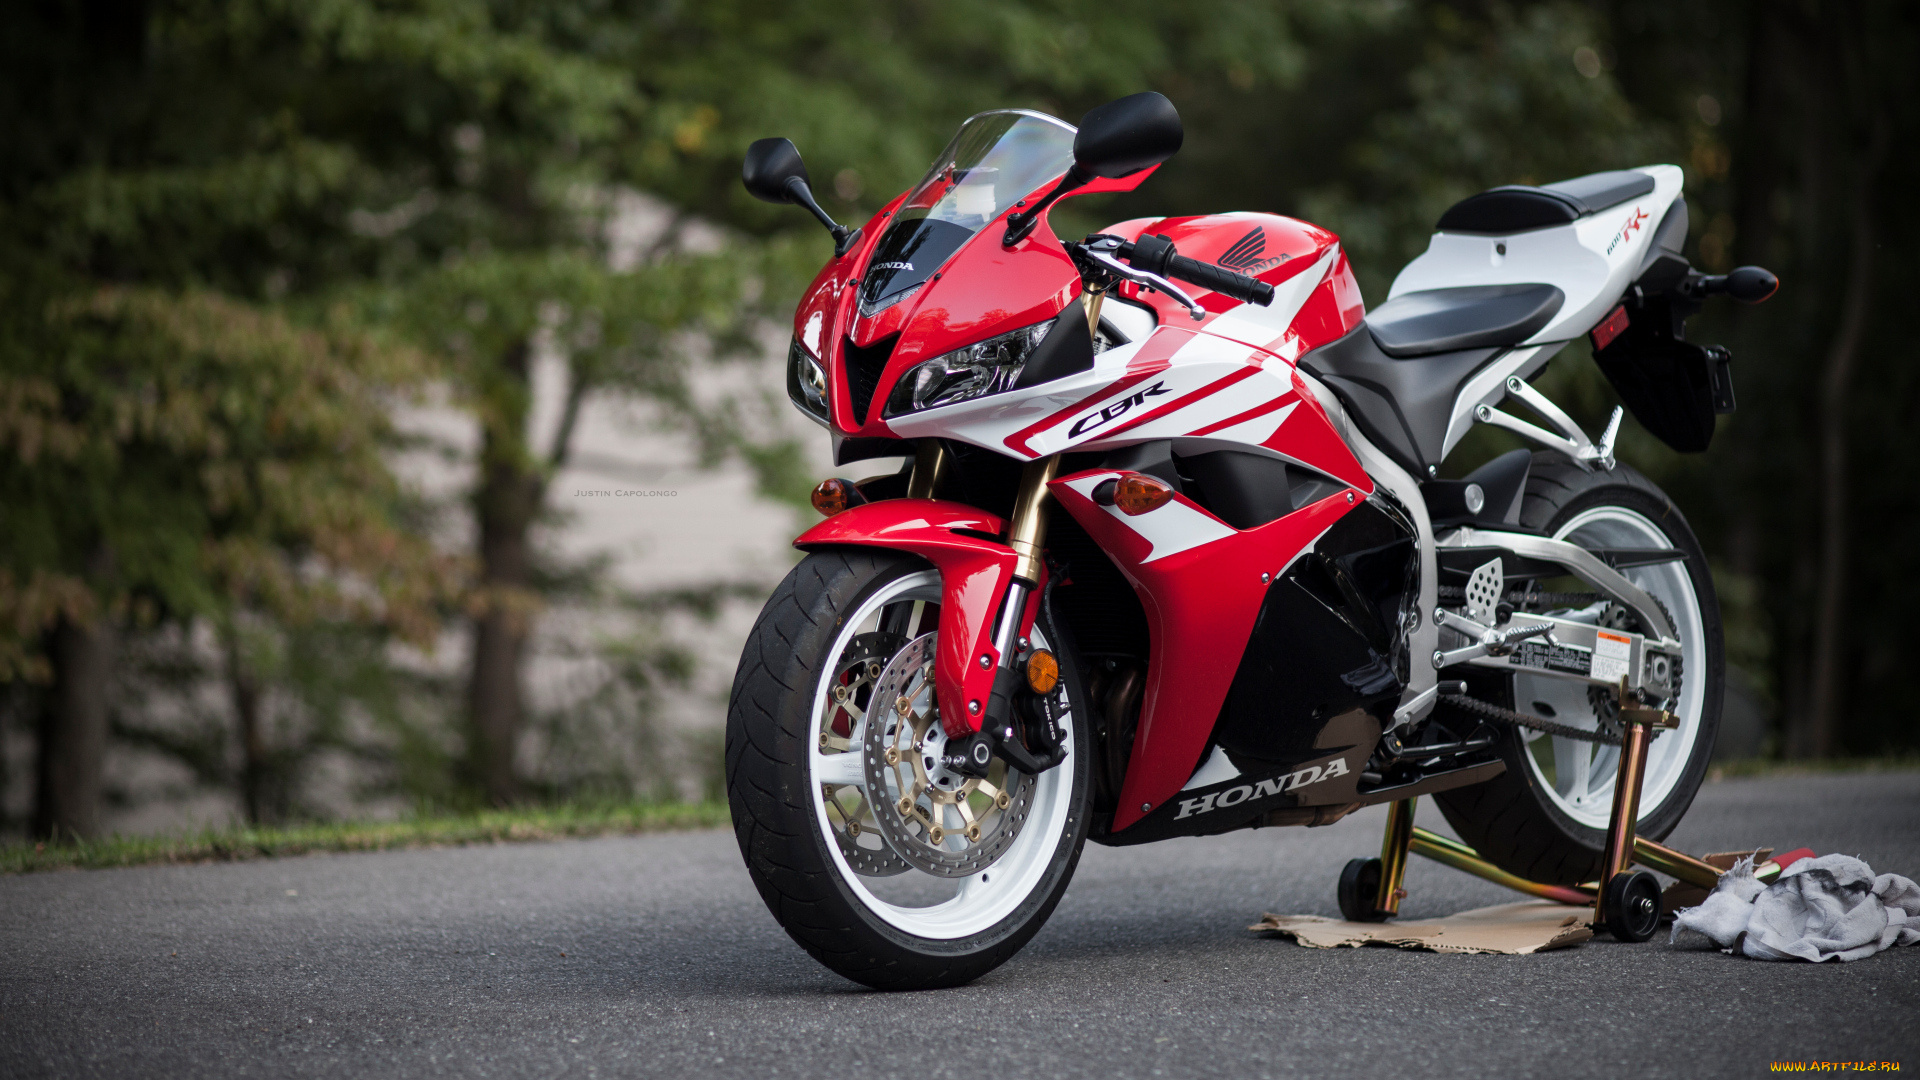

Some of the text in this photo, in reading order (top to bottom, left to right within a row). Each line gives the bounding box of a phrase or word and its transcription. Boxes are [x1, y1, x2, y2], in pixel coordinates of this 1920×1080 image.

[1238, 252, 1294, 276] ONDA
[1068, 380, 1174, 439] CBR
[1043, 697, 1056, 740] TOKICO
[1173, 757, 1350, 820] HONDA
